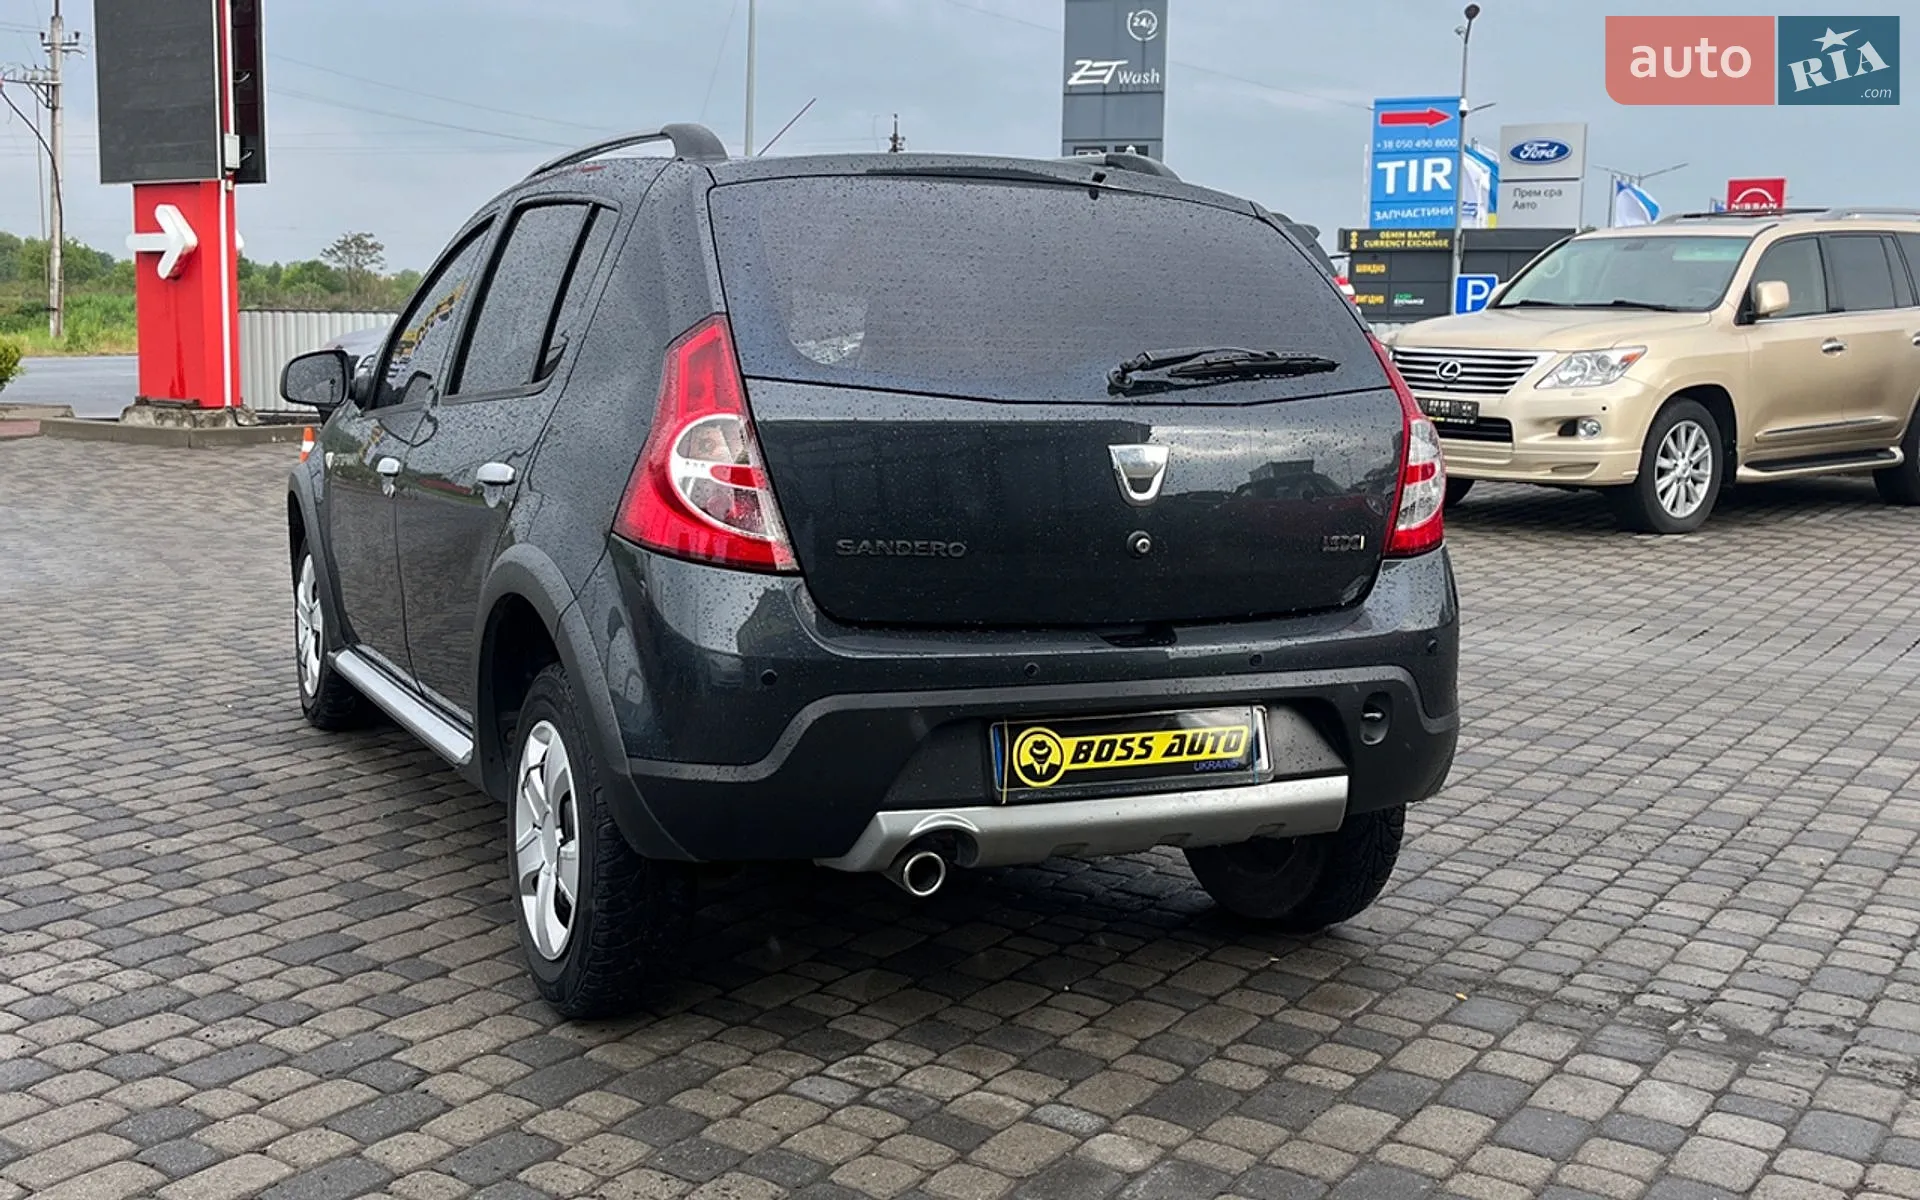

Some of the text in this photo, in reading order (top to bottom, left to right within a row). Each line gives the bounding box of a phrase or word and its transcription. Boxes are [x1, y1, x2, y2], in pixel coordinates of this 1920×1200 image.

[1067, 60, 1160, 85] ZET Wash
[1395, 139, 1414, 149] 050
[1415, 138, 1433, 148] 490
[1435, 137, 1458, 148] 8000
[1519, 142, 1559, 159] Ford
[1377, 157, 1452, 194] TIR
[1375, 206, 1454, 221] ЗАПЧАСТИНИ
[1512, 200, 1538, 210] Авто
[1731, 202, 1778, 211] NISSAN
[1363, 239, 1449, 249] CURRENCY EXCHANGE
[1466, 280, 1489, 311] P
[836, 539, 967, 557] SANDERO
[1070, 729, 1245, 765] BOSS AUTO
